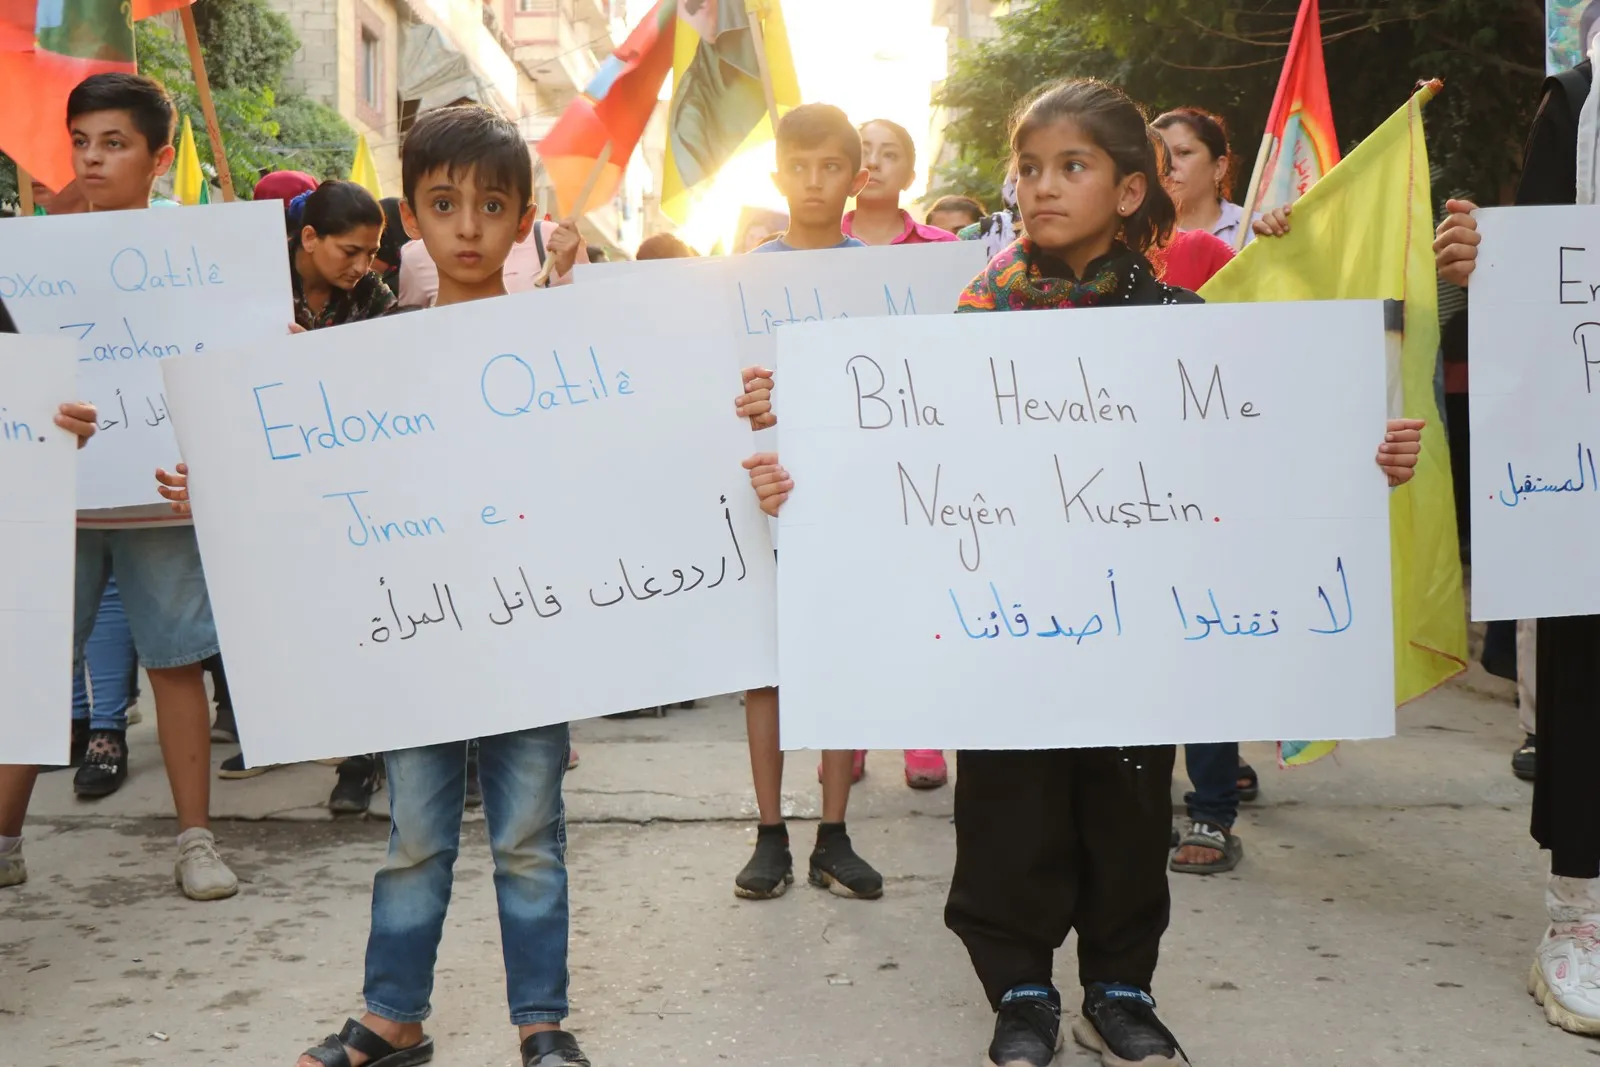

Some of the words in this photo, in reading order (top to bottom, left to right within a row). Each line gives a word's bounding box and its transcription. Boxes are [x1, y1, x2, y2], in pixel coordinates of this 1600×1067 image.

[110, 245, 225, 292] Qatilê
[60, 317, 181, 362] Zarokan
[253, 380, 436, 460] Erdoxan
[480, 346, 635, 417] Qatilê
[845, 355, 945, 430] Bila
[989, 357, 1138, 426] Hevalên
[1177, 359, 1261, 422] Me
[322, 490, 446, 547] Jinan
[588, 494, 747, 607] أردوغان
[897, 461, 1016, 572] Neyên
[1054, 454, 1221, 528] Kuştin.
[488, 565, 563, 625] قاتل
[1307, 556, 1353, 635] لا
